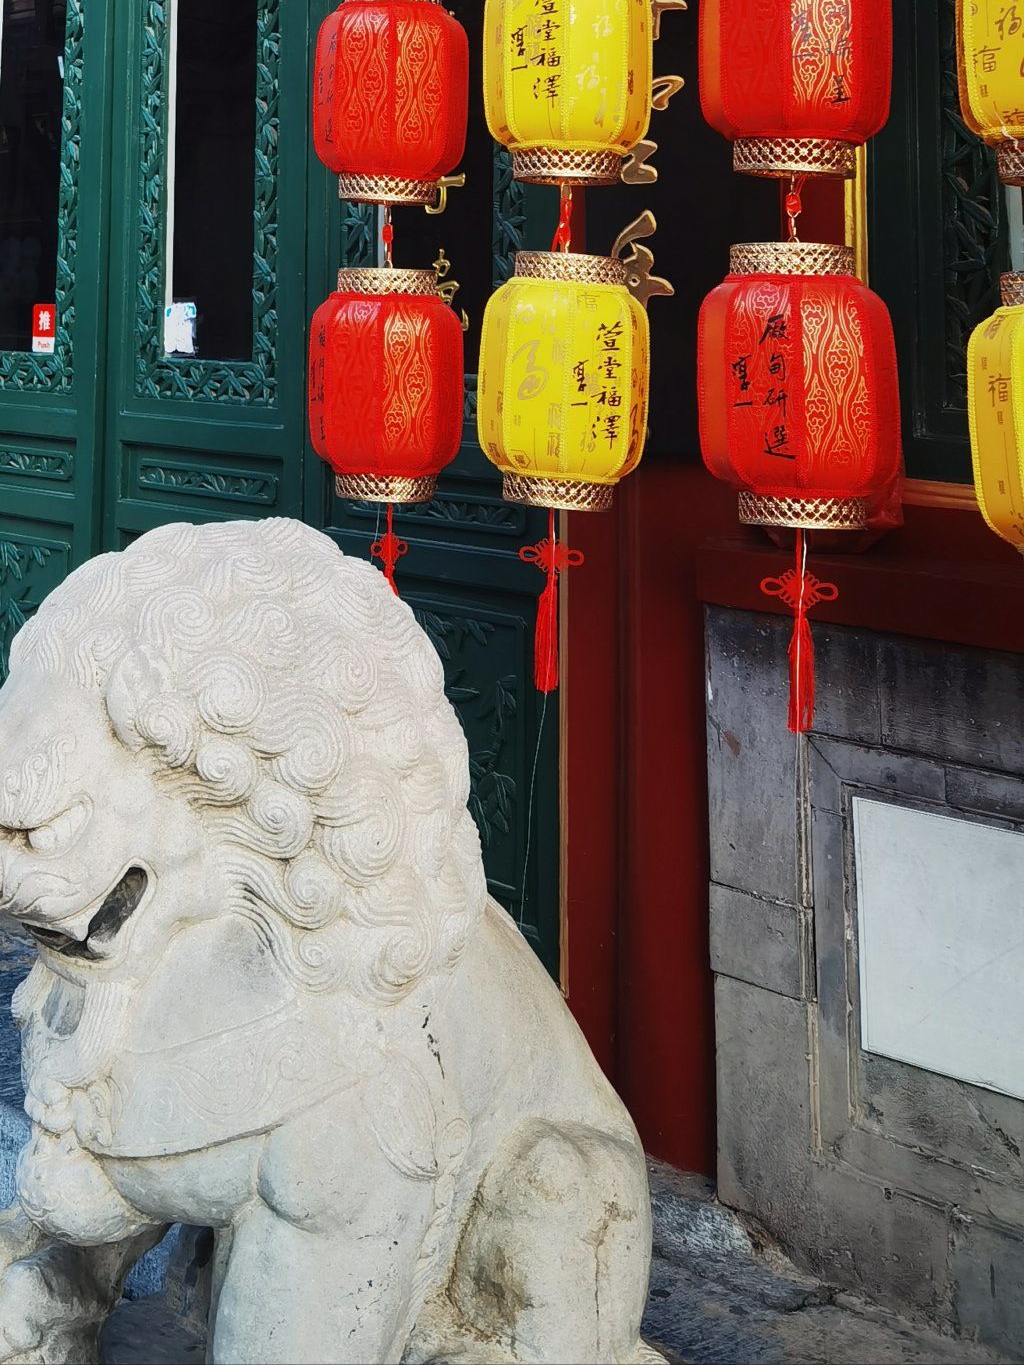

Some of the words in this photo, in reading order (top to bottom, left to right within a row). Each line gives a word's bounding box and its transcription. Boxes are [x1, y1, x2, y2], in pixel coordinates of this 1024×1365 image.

[38, 310, 51, 332] 推
[591, 321, 624, 450] 萱堂福澤
